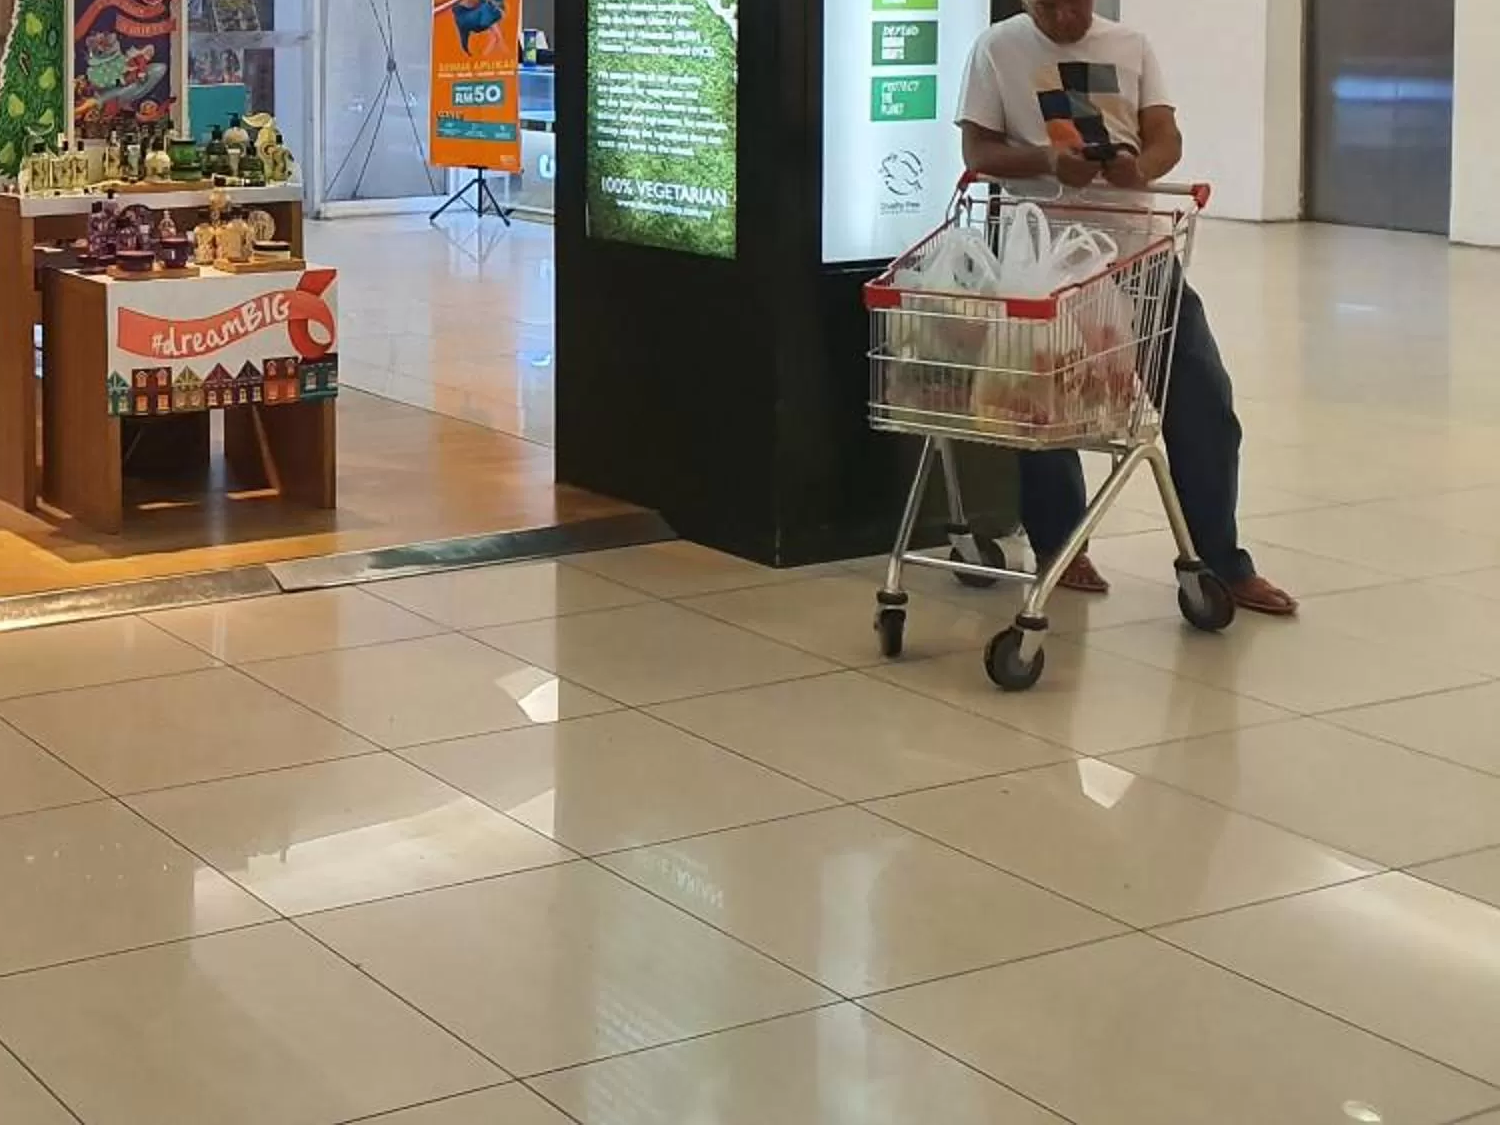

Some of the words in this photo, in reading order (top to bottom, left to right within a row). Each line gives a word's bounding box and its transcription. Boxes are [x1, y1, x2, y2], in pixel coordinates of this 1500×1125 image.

[601, 176, 634, 196] 100%
[635, 180, 728, 208] VEGETARIAN
[151, 293, 291, 357] #dreamBIG
